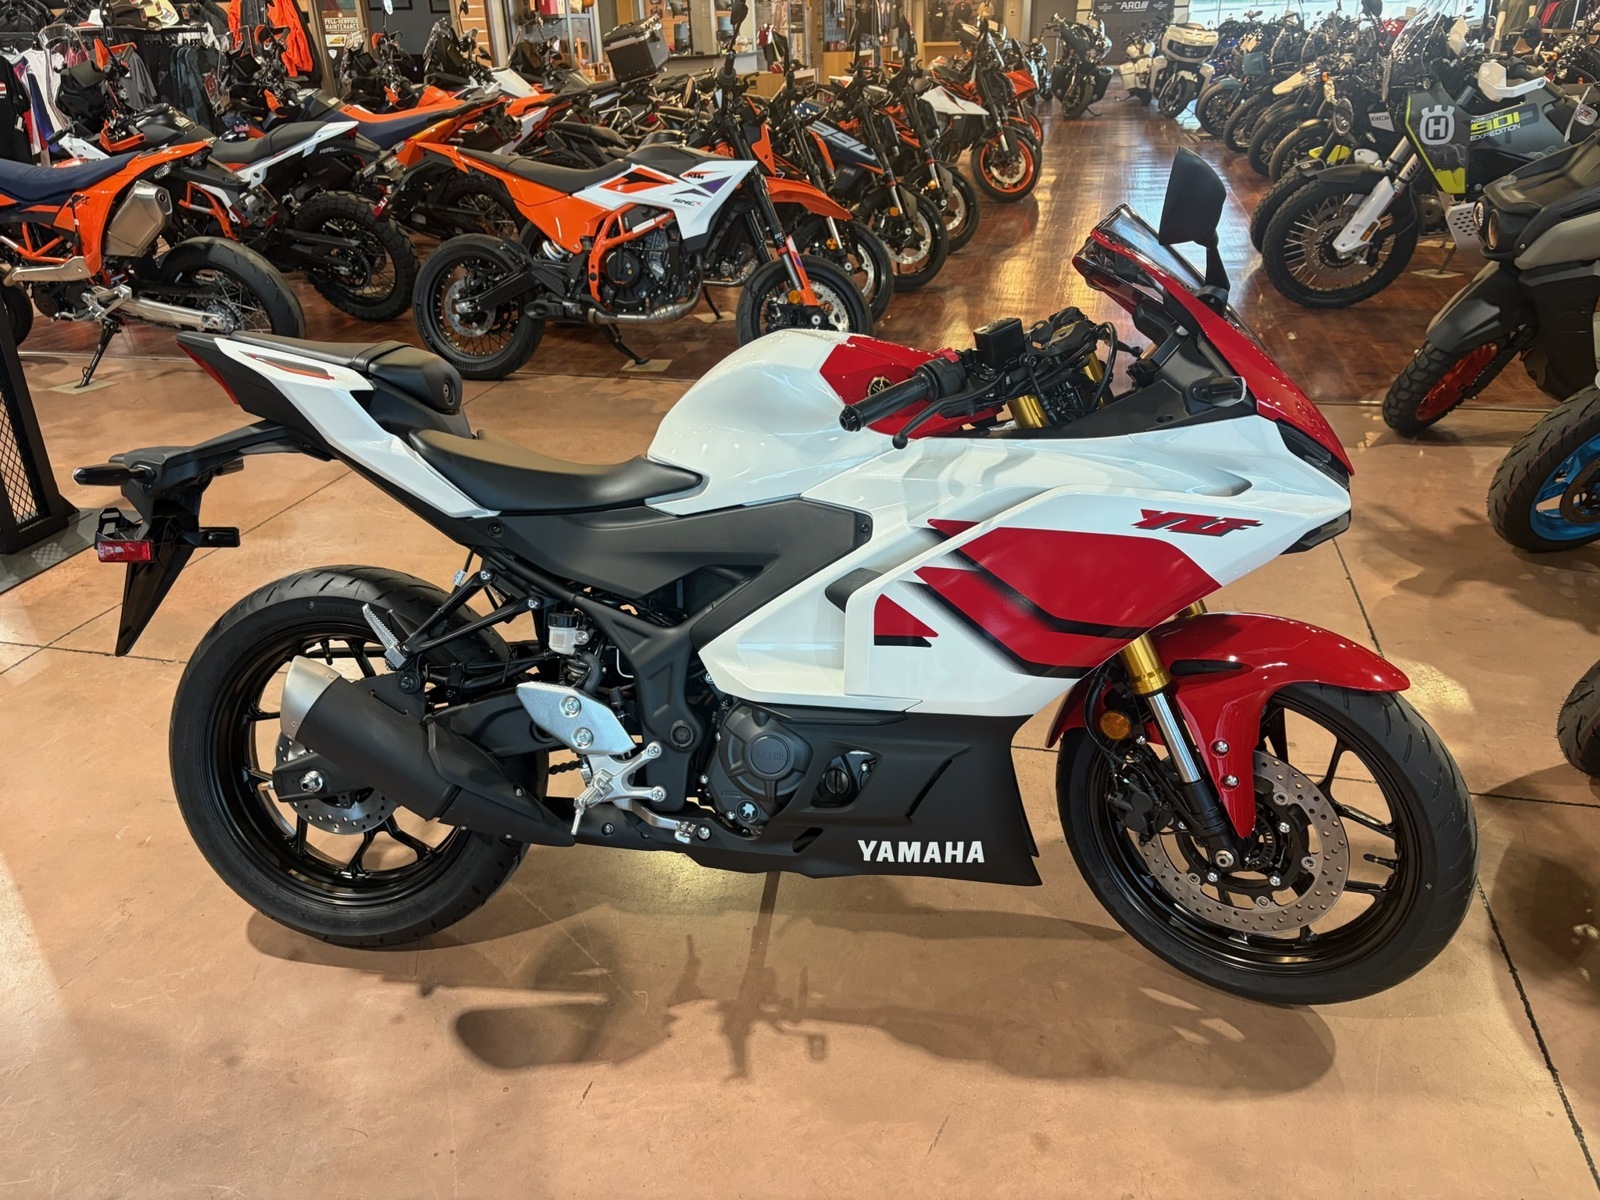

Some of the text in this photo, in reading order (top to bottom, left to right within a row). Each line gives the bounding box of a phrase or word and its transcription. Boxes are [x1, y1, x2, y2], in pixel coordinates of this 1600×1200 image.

[1470, 113, 1499, 123] NORDEN
[1470, 111, 1520, 135] 901
[1470, 124, 1521, 142] EXPEDITION
[857, 839, 985, 863] YAMAHA
